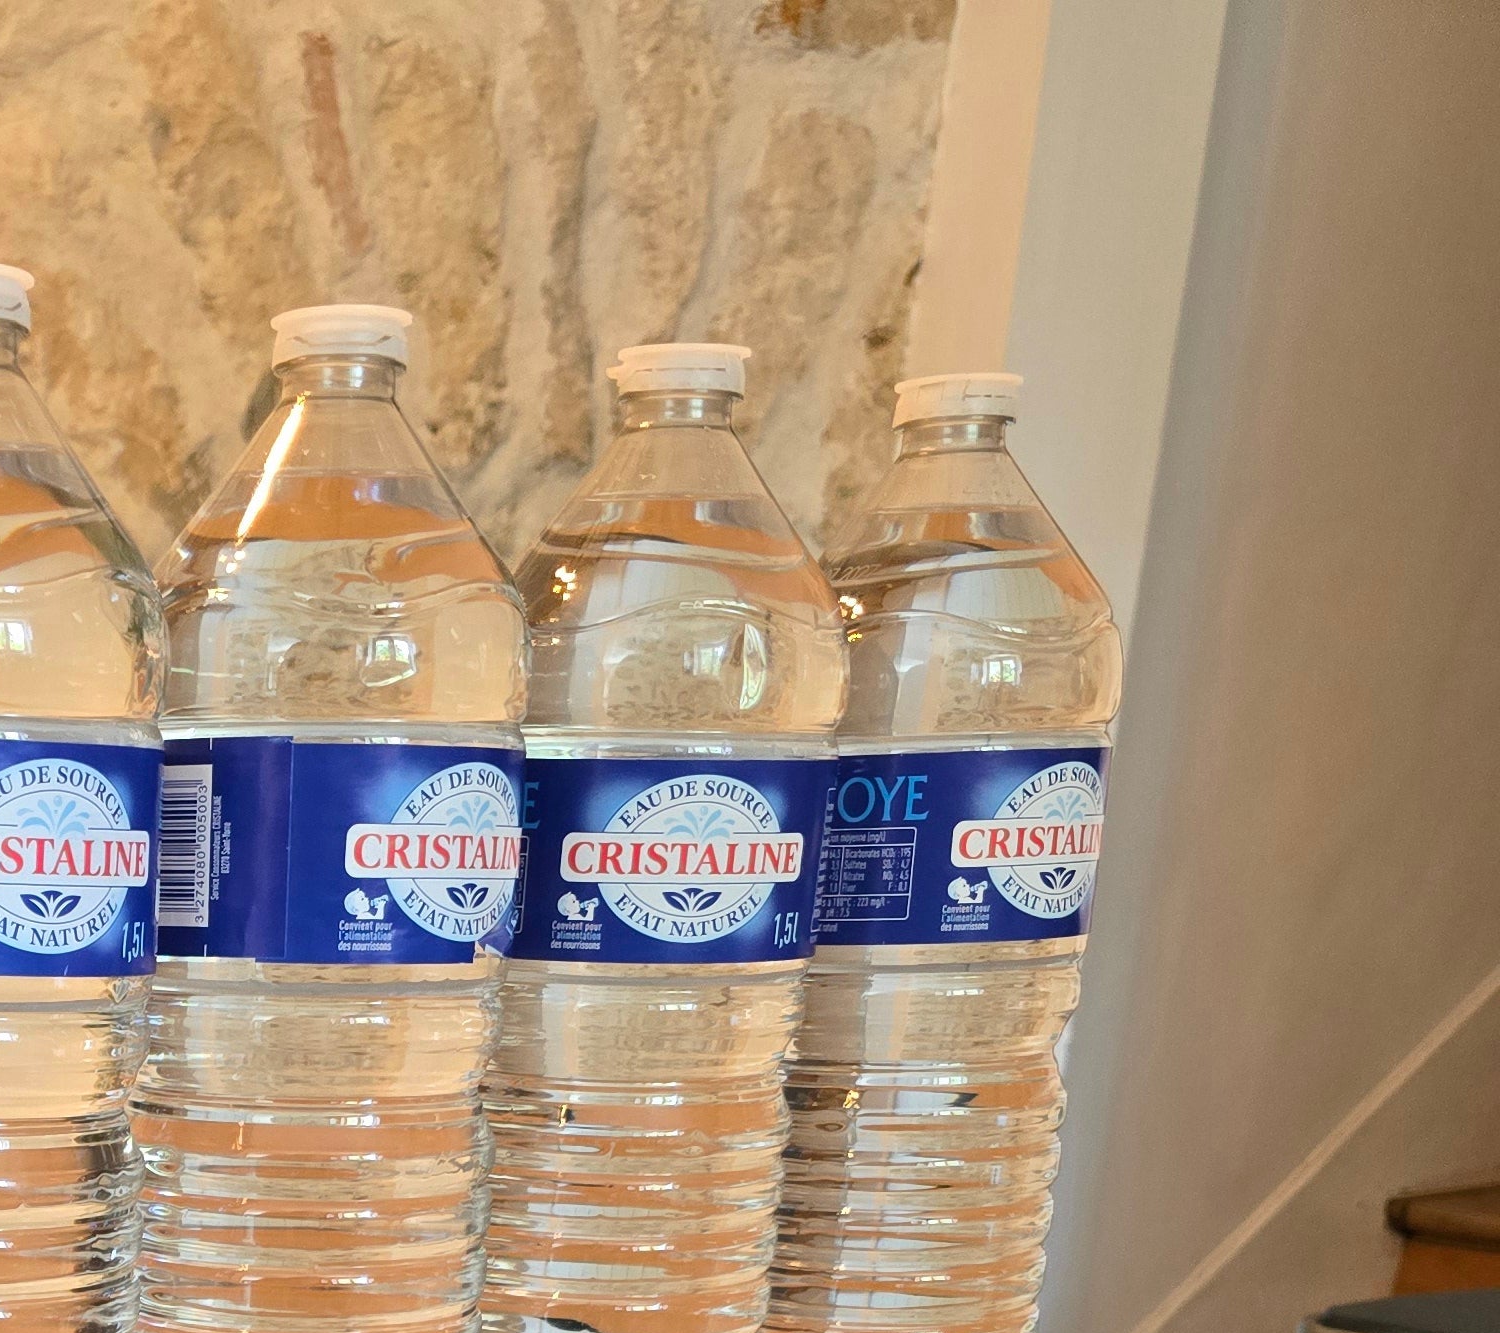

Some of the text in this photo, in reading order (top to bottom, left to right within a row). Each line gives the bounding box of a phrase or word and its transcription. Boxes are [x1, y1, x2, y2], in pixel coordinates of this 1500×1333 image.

[19, 765, 51, 787] DE
[56, 765, 125, 825] SOURCE
[405, 777, 443, 819] EAU
[449, 768, 473, 790] DE
[1006, 776, 1043, 814] EAU
[1048, 767, 1068, 787] DE
[618, 789, 662, 829] EAU
[669, 780, 698, 800] DE
[703, 780, 773, 829] SOURCE
[195, 785, 208, 923] 3 274080 005003
[210, 795, 222, 900] Service Consommateurs CRISTALINE
[568, 841, 799, 875] CRISTALINE
[900, 847, 911, 858] 195
[856, 897, 869, 907] 223
[1002, 874, 1044, 911] ETAT
[403, 888, 449, 931] ETAT
[453, 892, 510, 936] NATUREL
[614, 893, 762, 938] ETAT NATUREL
[941, 913, 990, 923] l'alimentation
[942, 904, 991, 914] Convient pour
[30, 898, 118, 948] NATUREL
[338, 920, 393, 932] Convient pour
[552, 920, 602, 933] Convient pour
[941, 922, 989, 932] des nourrissons
[338, 929, 394, 941] l'alimentation
[338, 941, 392, 951] des nourrissons
[551, 930, 601, 942] l'alimentation
[551, 940, 601, 950] des nourrissons
